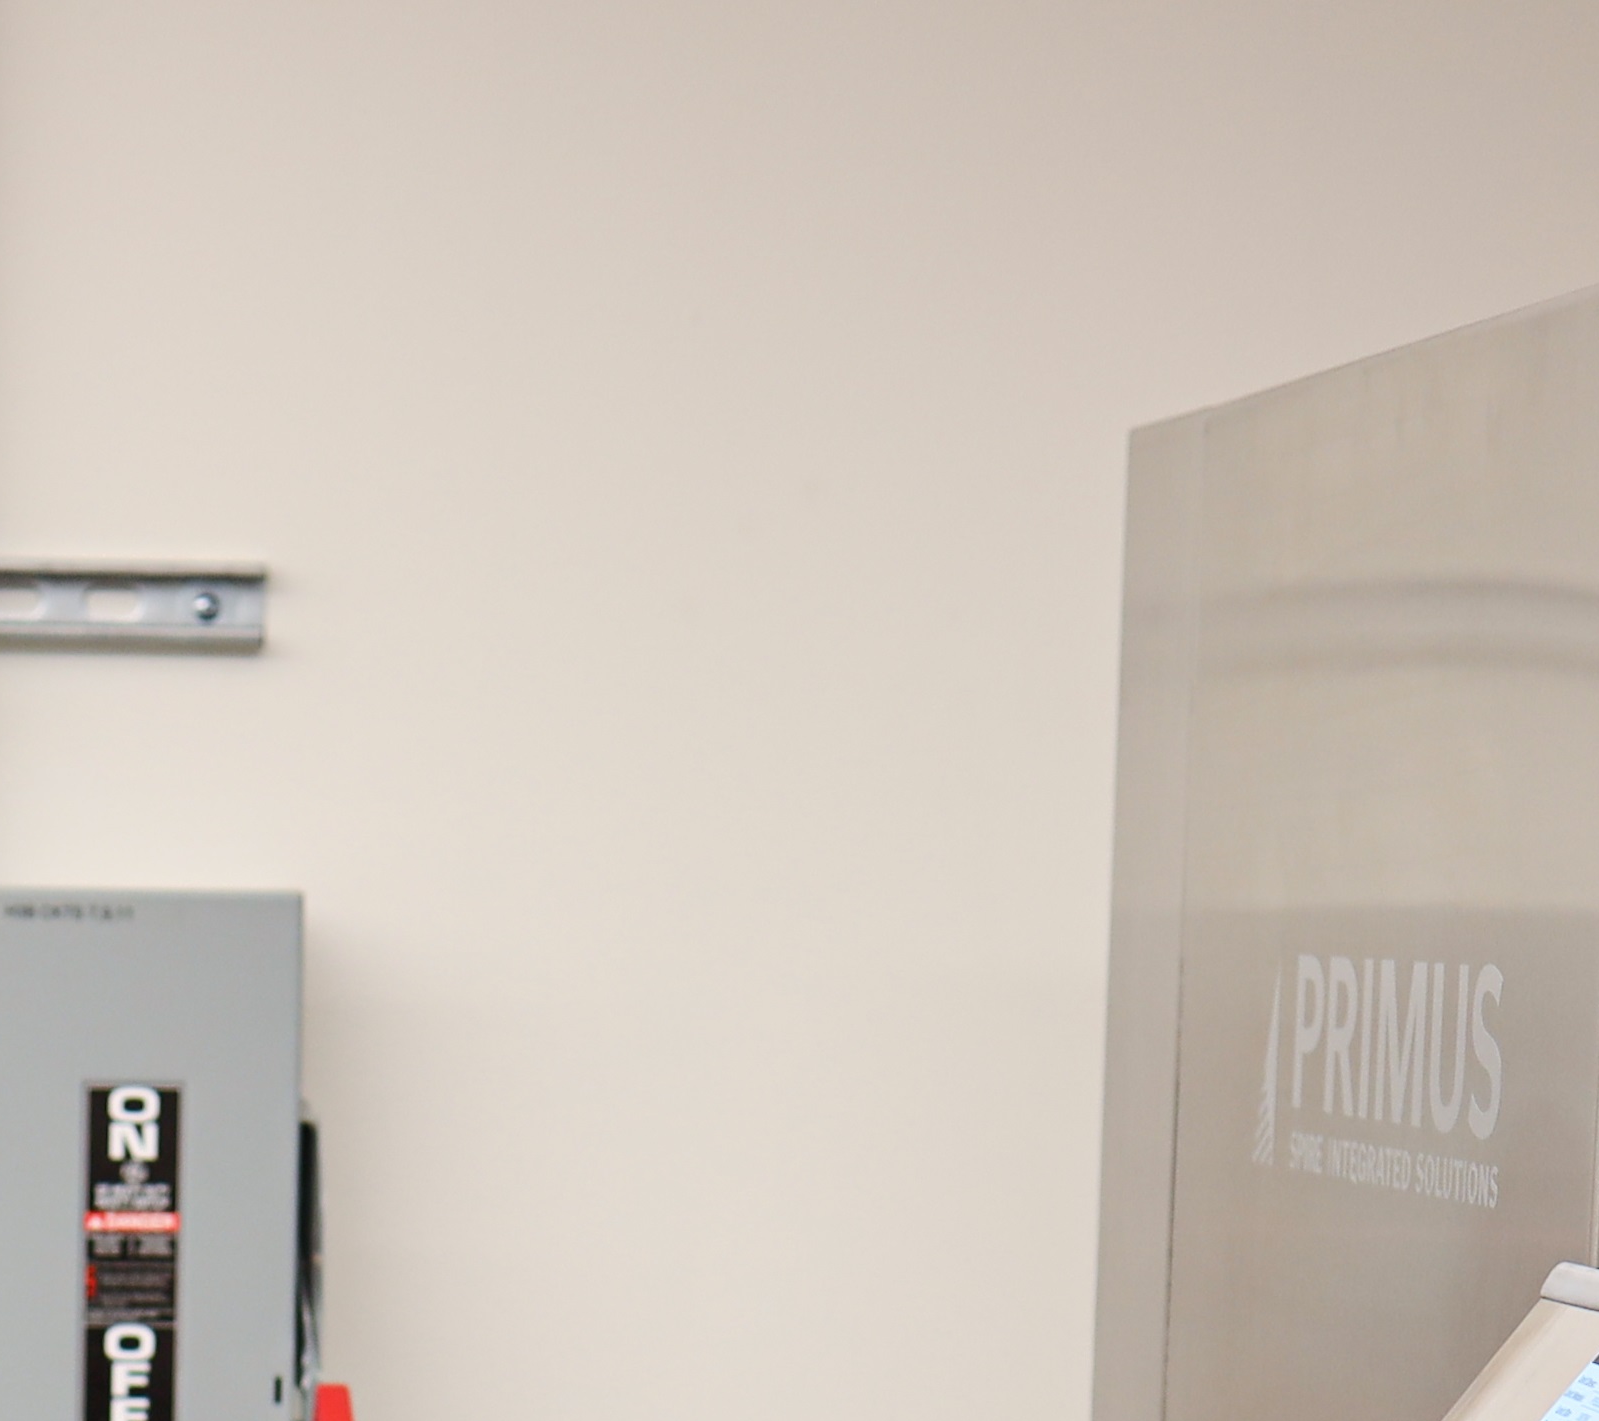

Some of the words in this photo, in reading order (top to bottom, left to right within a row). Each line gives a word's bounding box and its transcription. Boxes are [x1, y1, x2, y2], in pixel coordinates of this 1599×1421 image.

[1291, 954, 1503, 1140] PRIMUS
[106, 1085, 161, 1162] ON
[1328, 1136, 1412, 1191] INTEGRATED
[1415, 1152, 1500, 1209] SOLUTIONS
